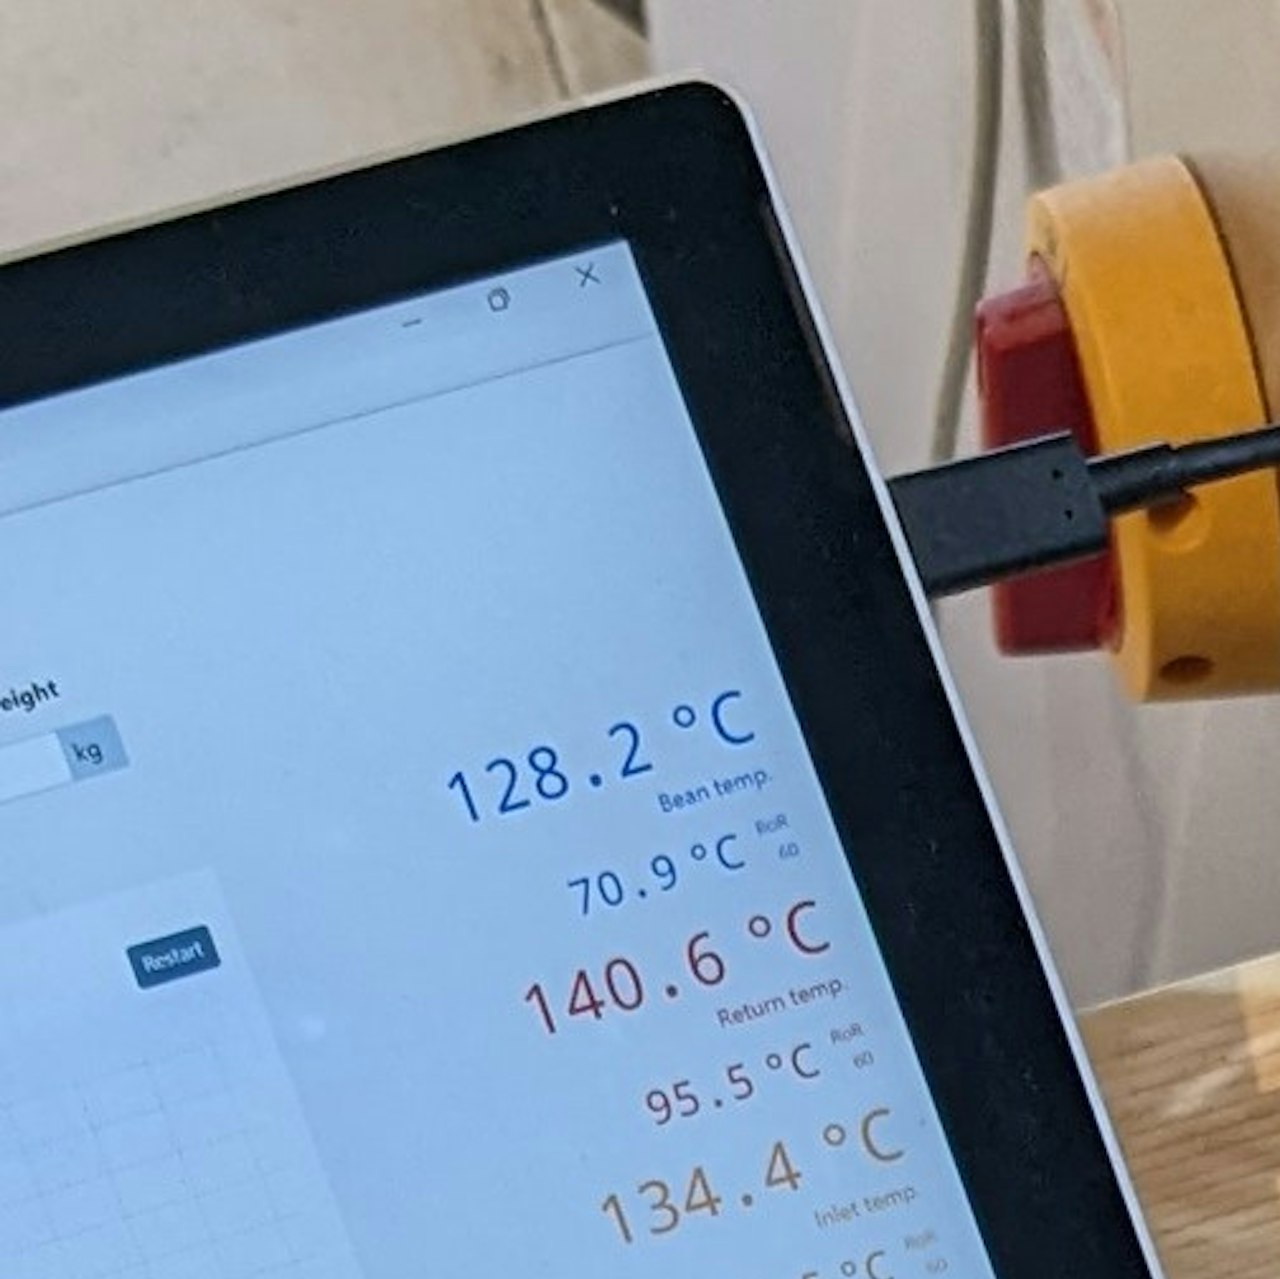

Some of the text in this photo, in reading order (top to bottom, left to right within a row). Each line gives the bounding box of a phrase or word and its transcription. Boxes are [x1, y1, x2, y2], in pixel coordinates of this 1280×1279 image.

[73, 743, 102, 764] kg
[658, 768, 773, 814] Bean temp.
[142, 941, 203, 975] Restart
[718, 977, 848, 1029] Return temp.
[814, 1203, 859, 1229] Inlet
